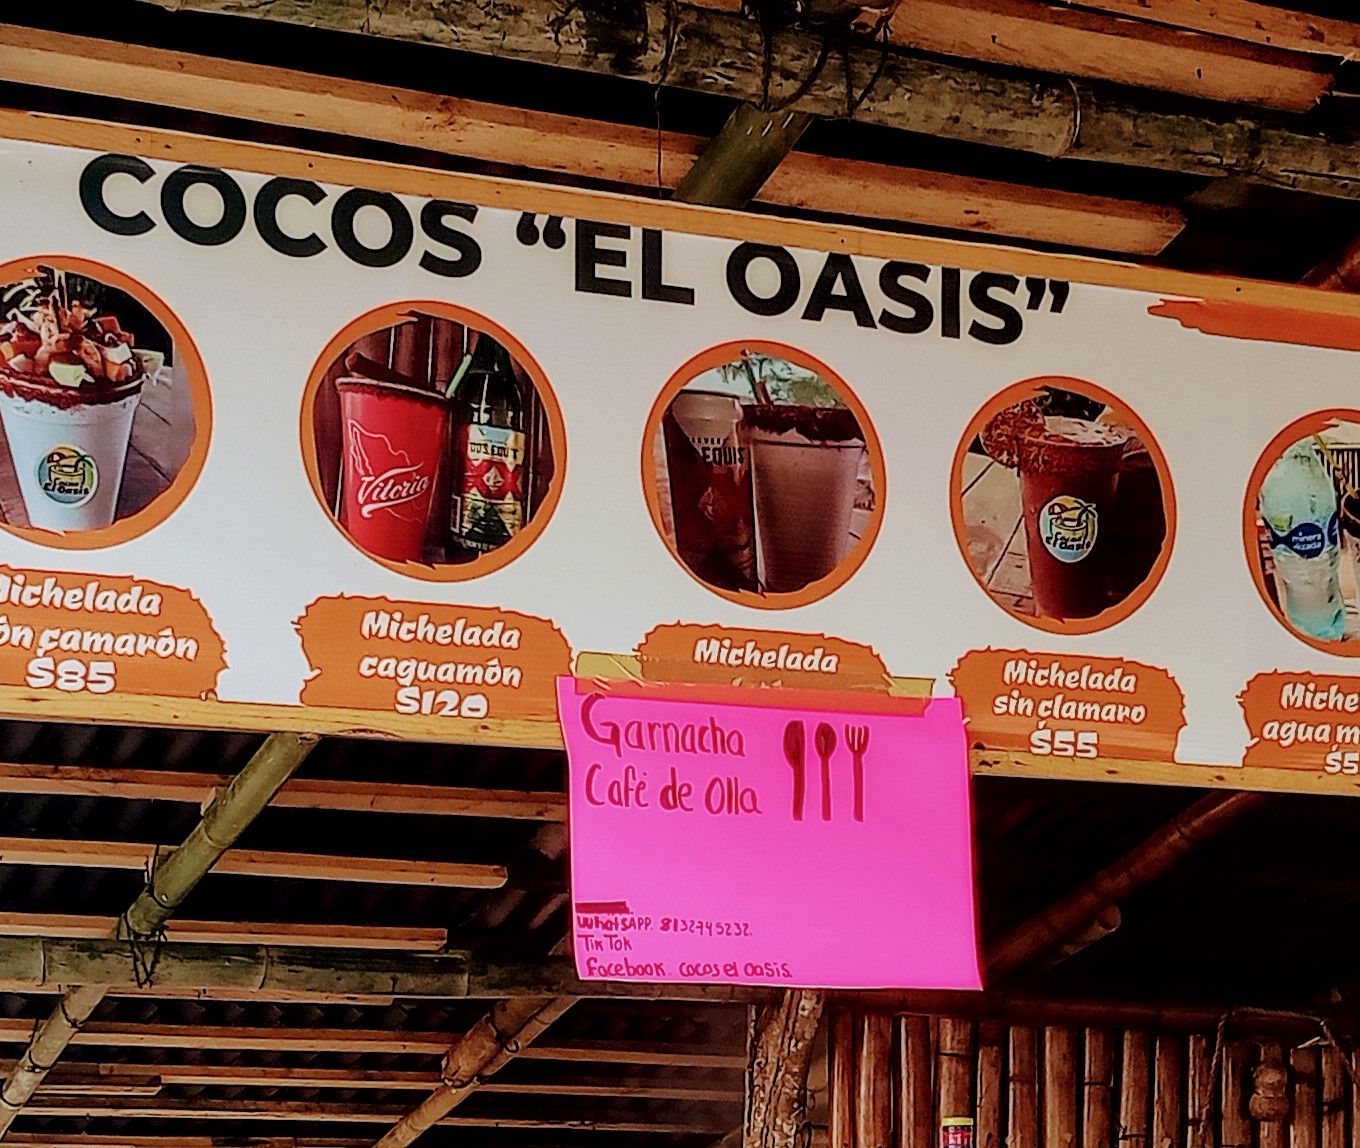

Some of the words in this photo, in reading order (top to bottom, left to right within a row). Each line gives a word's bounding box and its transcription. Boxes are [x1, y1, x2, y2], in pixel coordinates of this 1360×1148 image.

[80, 154, 482, 279] COCOS
[516, 212, 695, 306] “EL
[725, 243, 1070, 346] OASIS”
[39, 626, 200, 661] camarón
[360, 609, 522, 650] Michelada
[25, 649, 116, 695] $85
[358, 655, 522, 688] caguamón
[693, 636, 839, 674] Michelada
[1003, 657, 1137, 696] Michelada
[394, 685, 490, 720] $120
[993, 689, 1035, 717] sin
[580, 692, 746, 758] Garnacha
[1029, 718, 1100, 761] $55
[1262, 719, 1334, 748] agua
[585, 763, 649, 808] Café
[659, 767, 693, 812] de
[704, 776, 763, 816] Olla
